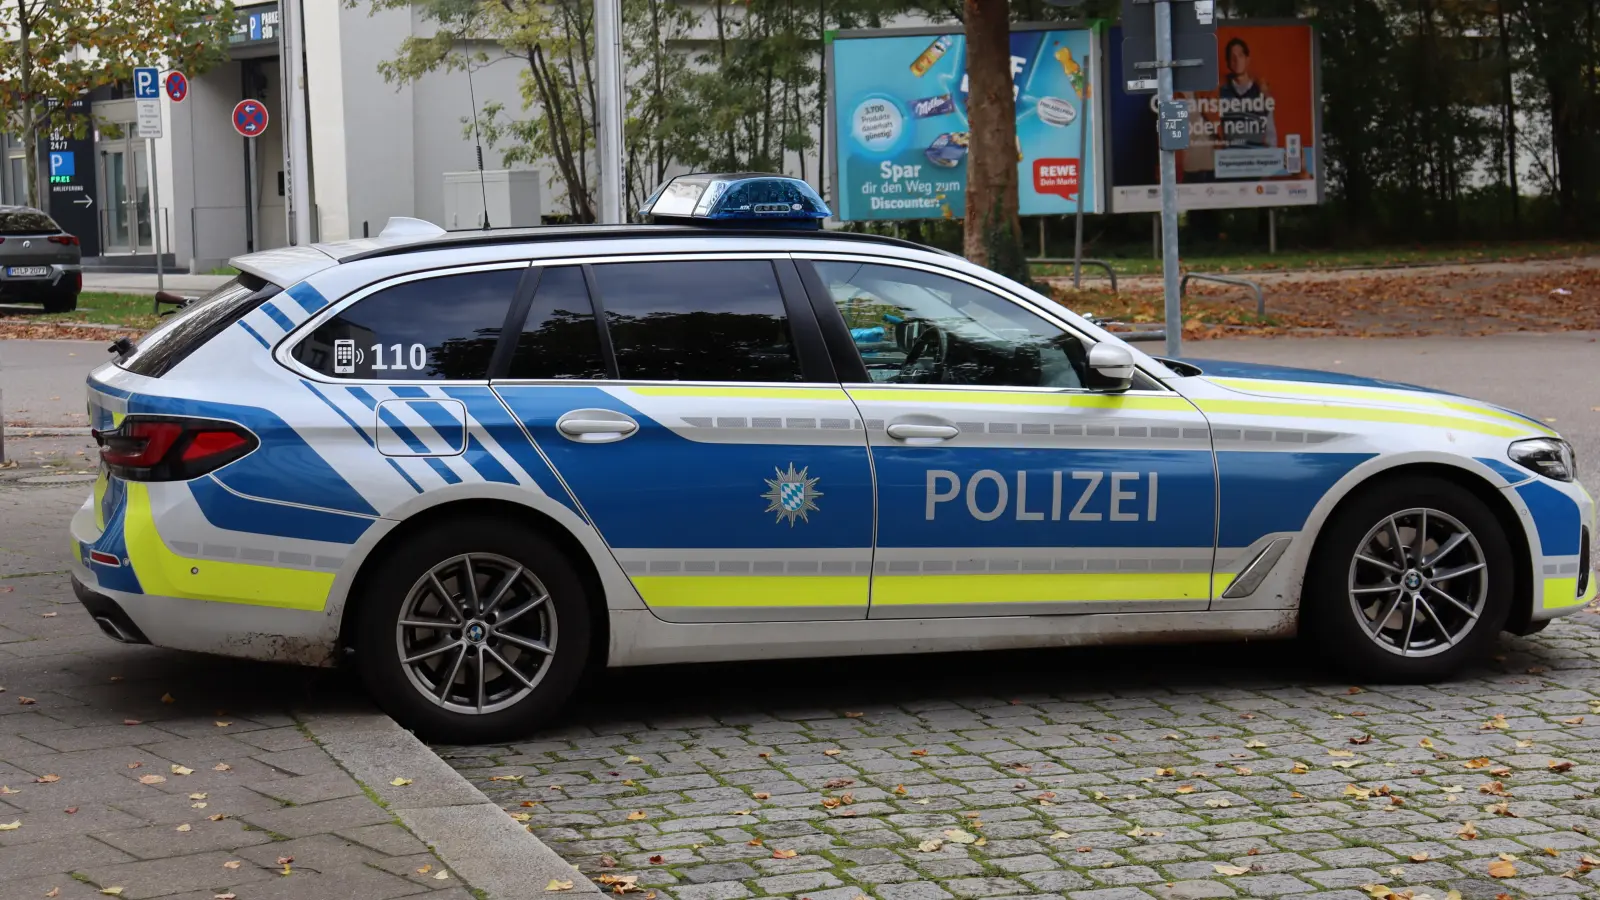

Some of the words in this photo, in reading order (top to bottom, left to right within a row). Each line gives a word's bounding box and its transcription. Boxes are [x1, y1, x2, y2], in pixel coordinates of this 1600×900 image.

[261, 11, 279, 25] PARKE
[138, 71, 152, 96] P
[1224, 116, 1267, 135] nein?
[50, 141, 68, 150] 24/7
[881, 160, 921, 182] Spar
[1040, 165, 1076, 177] REWE
[862, 182, 877, 194] dir
[881, 181, 902, 193] den
[905, 180, 932, 195] Weg
[936, 181, 960, 192] zum
[1040, 178, 1056, 187] Dein
[371, 343, 426, 370] 110
[925, 469, 1158, 521] POLIZEI
